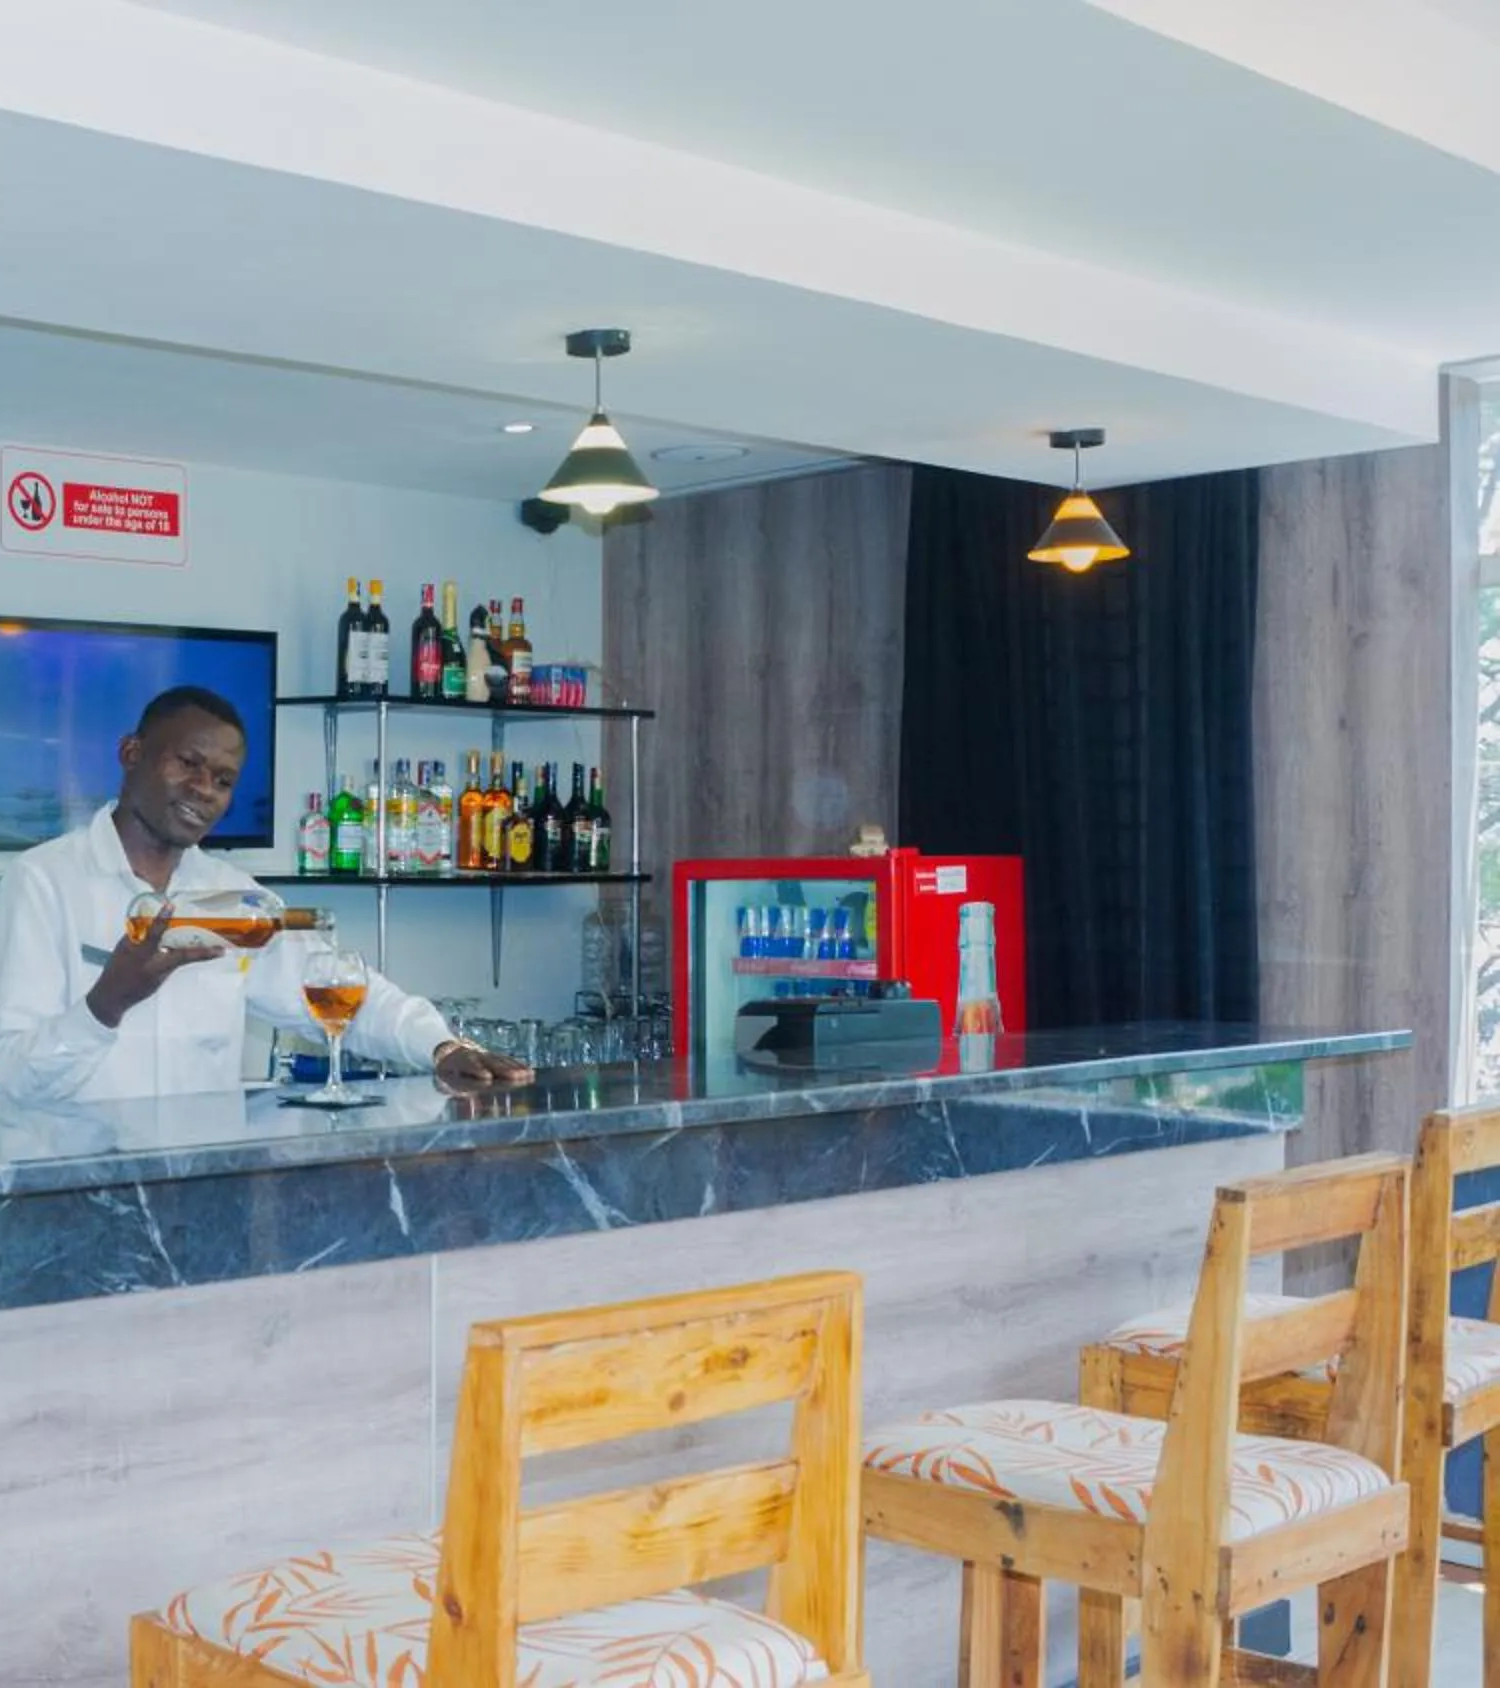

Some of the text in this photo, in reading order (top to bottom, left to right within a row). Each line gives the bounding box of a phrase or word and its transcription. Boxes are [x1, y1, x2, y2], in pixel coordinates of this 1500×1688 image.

[89, 488, 154, 507] Alcohol NOT
[73, 500, 169, 521] for sale to persons
[72, 514, 171, 532] under the age of 18
